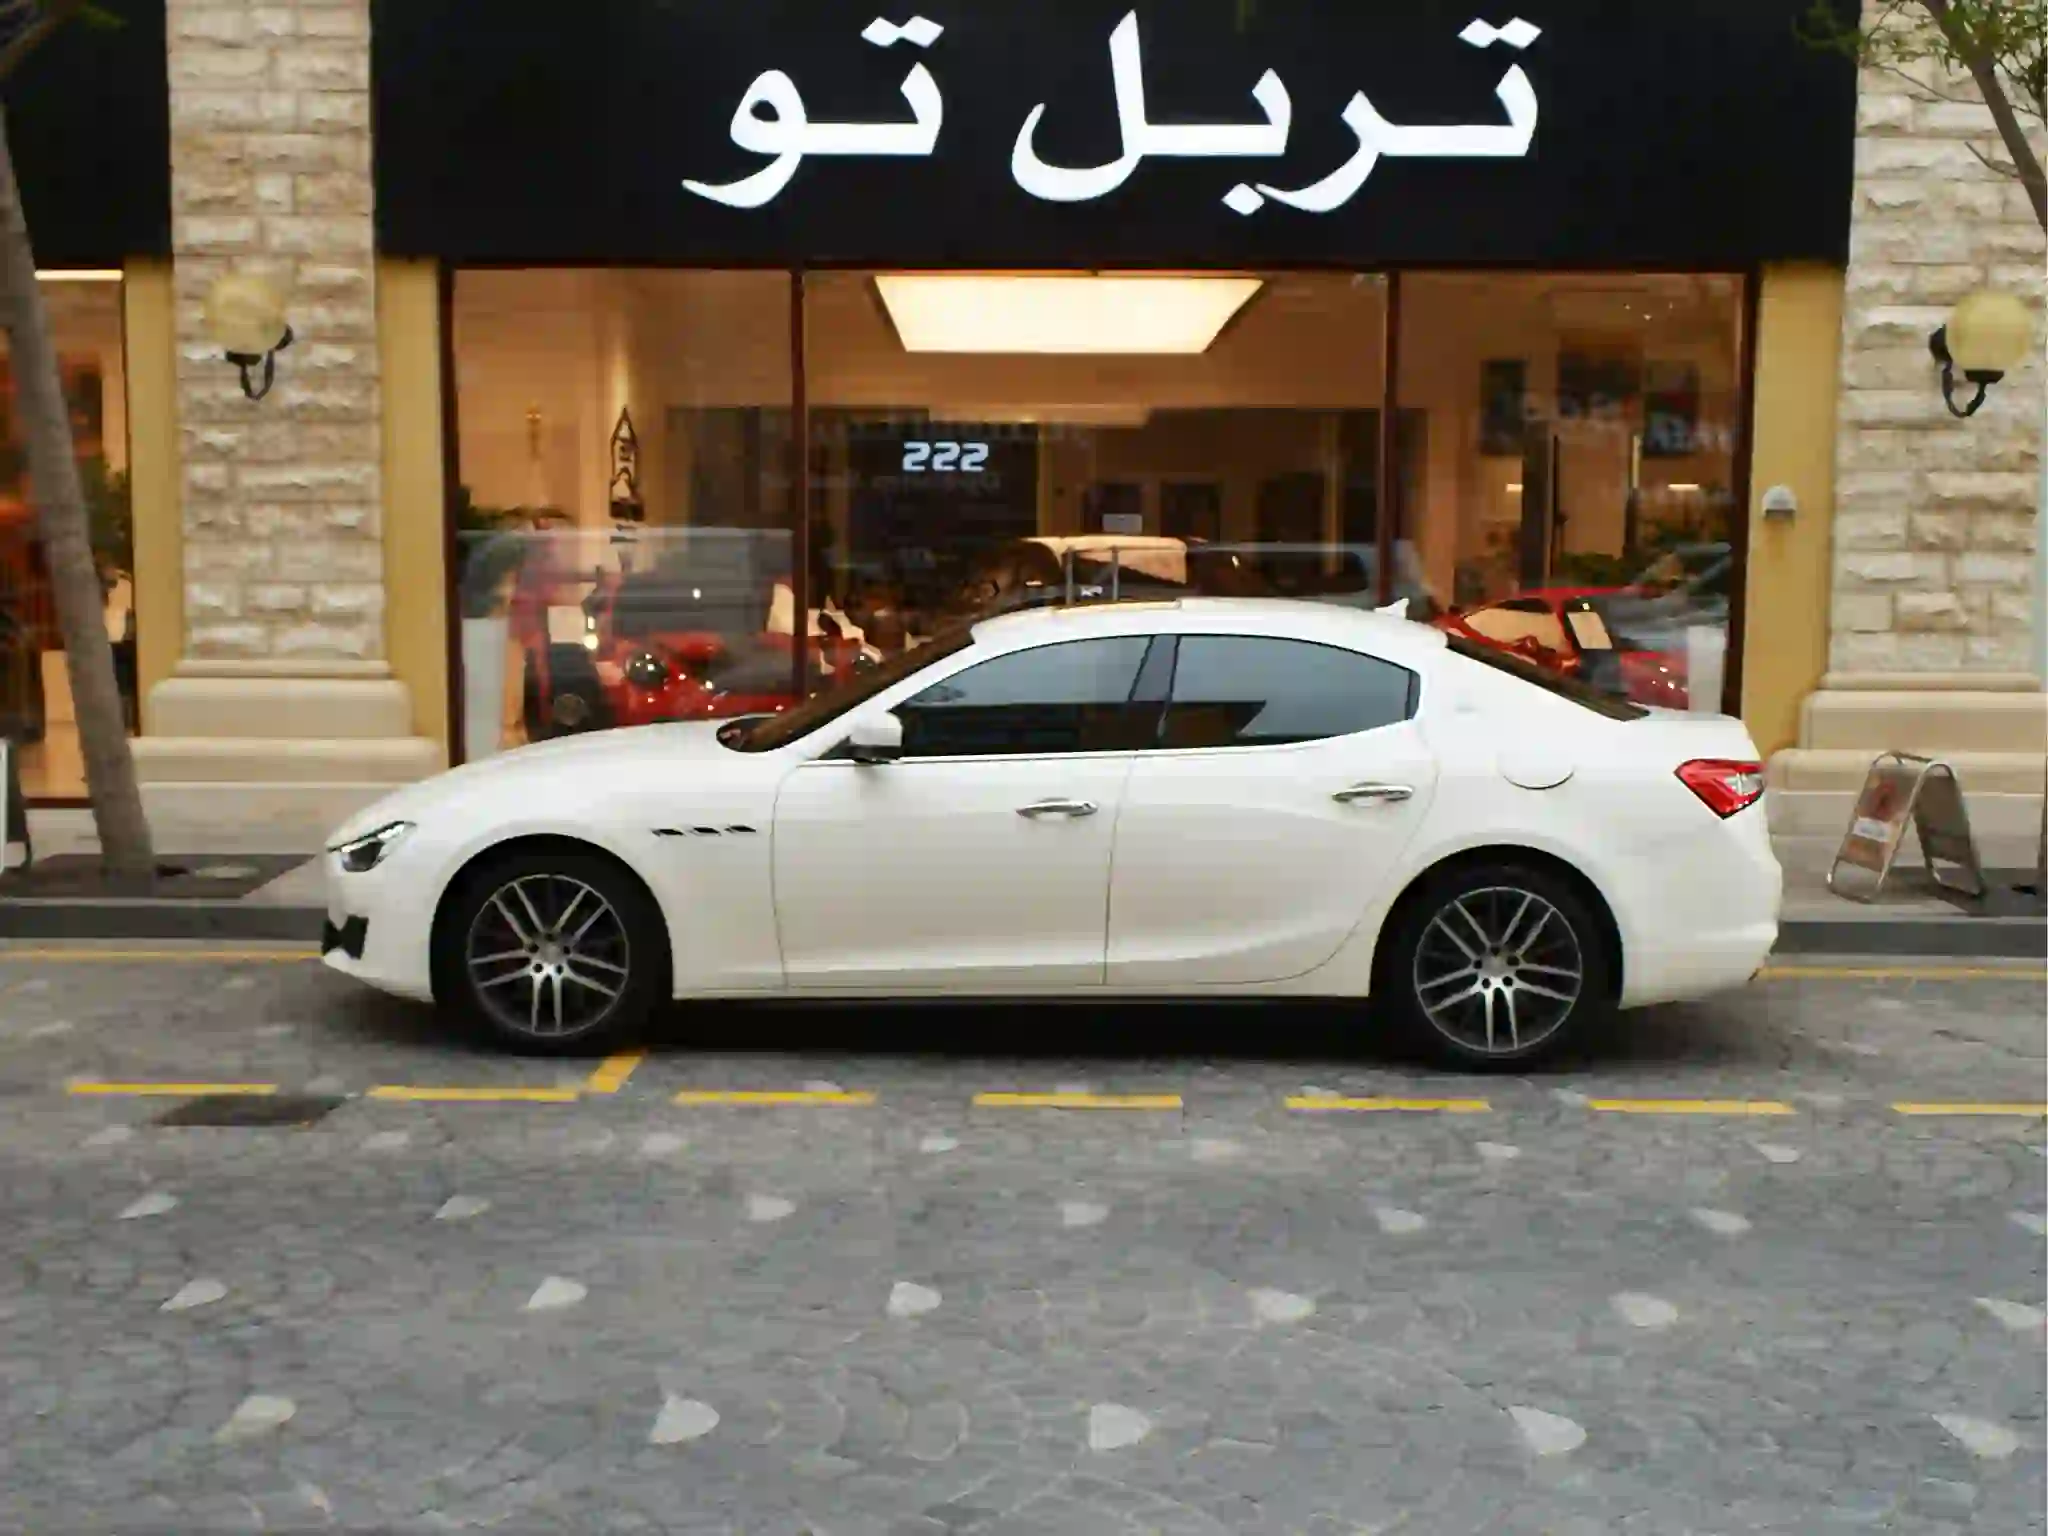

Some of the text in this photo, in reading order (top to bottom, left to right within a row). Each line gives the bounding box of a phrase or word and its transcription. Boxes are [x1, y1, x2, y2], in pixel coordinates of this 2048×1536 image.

[682, 10, 1542, 215] تربل تو
[902, 441, 989, 472] 222
